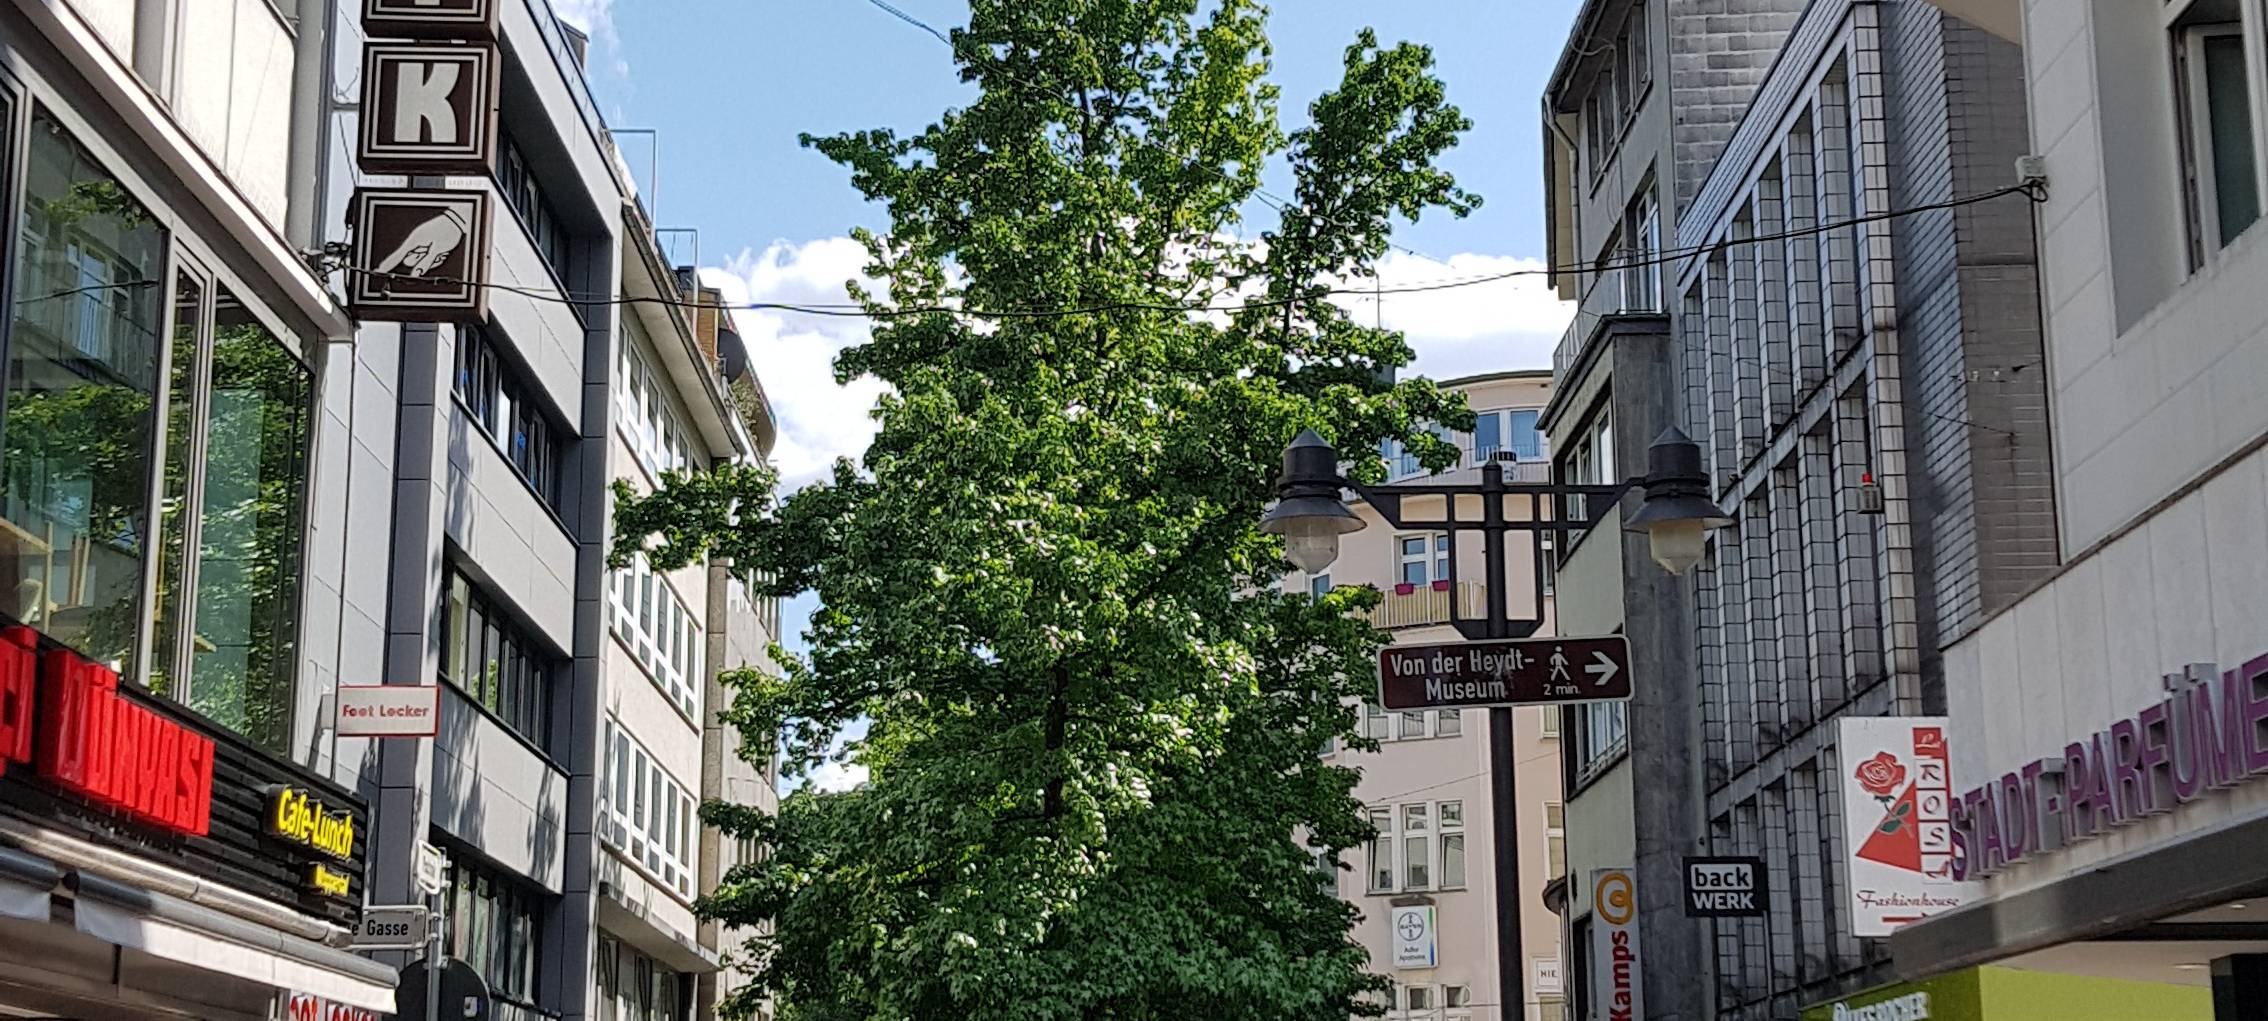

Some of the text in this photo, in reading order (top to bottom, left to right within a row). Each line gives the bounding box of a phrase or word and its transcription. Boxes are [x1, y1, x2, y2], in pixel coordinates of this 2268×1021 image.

[394, 0, 461, 143] K
[1390, 648, 1535, 677] Von der Heydt-
[1426, 678, 1506, 701] Museum
[1543, 682, 1581, 696] 2 min.
[342, 704, 429, 717] Foot Locker
[278, 788, 354, 859] Cafe-Lunch
[1694, 867, 1750, 887] back
[1691, 892, 1755, 910] WERK
[1856, 889, 1960, 909] Fashionhouse
[367, 919, 409, 936] Gasse
[1609, 930, 1636, 1021] Kamps
